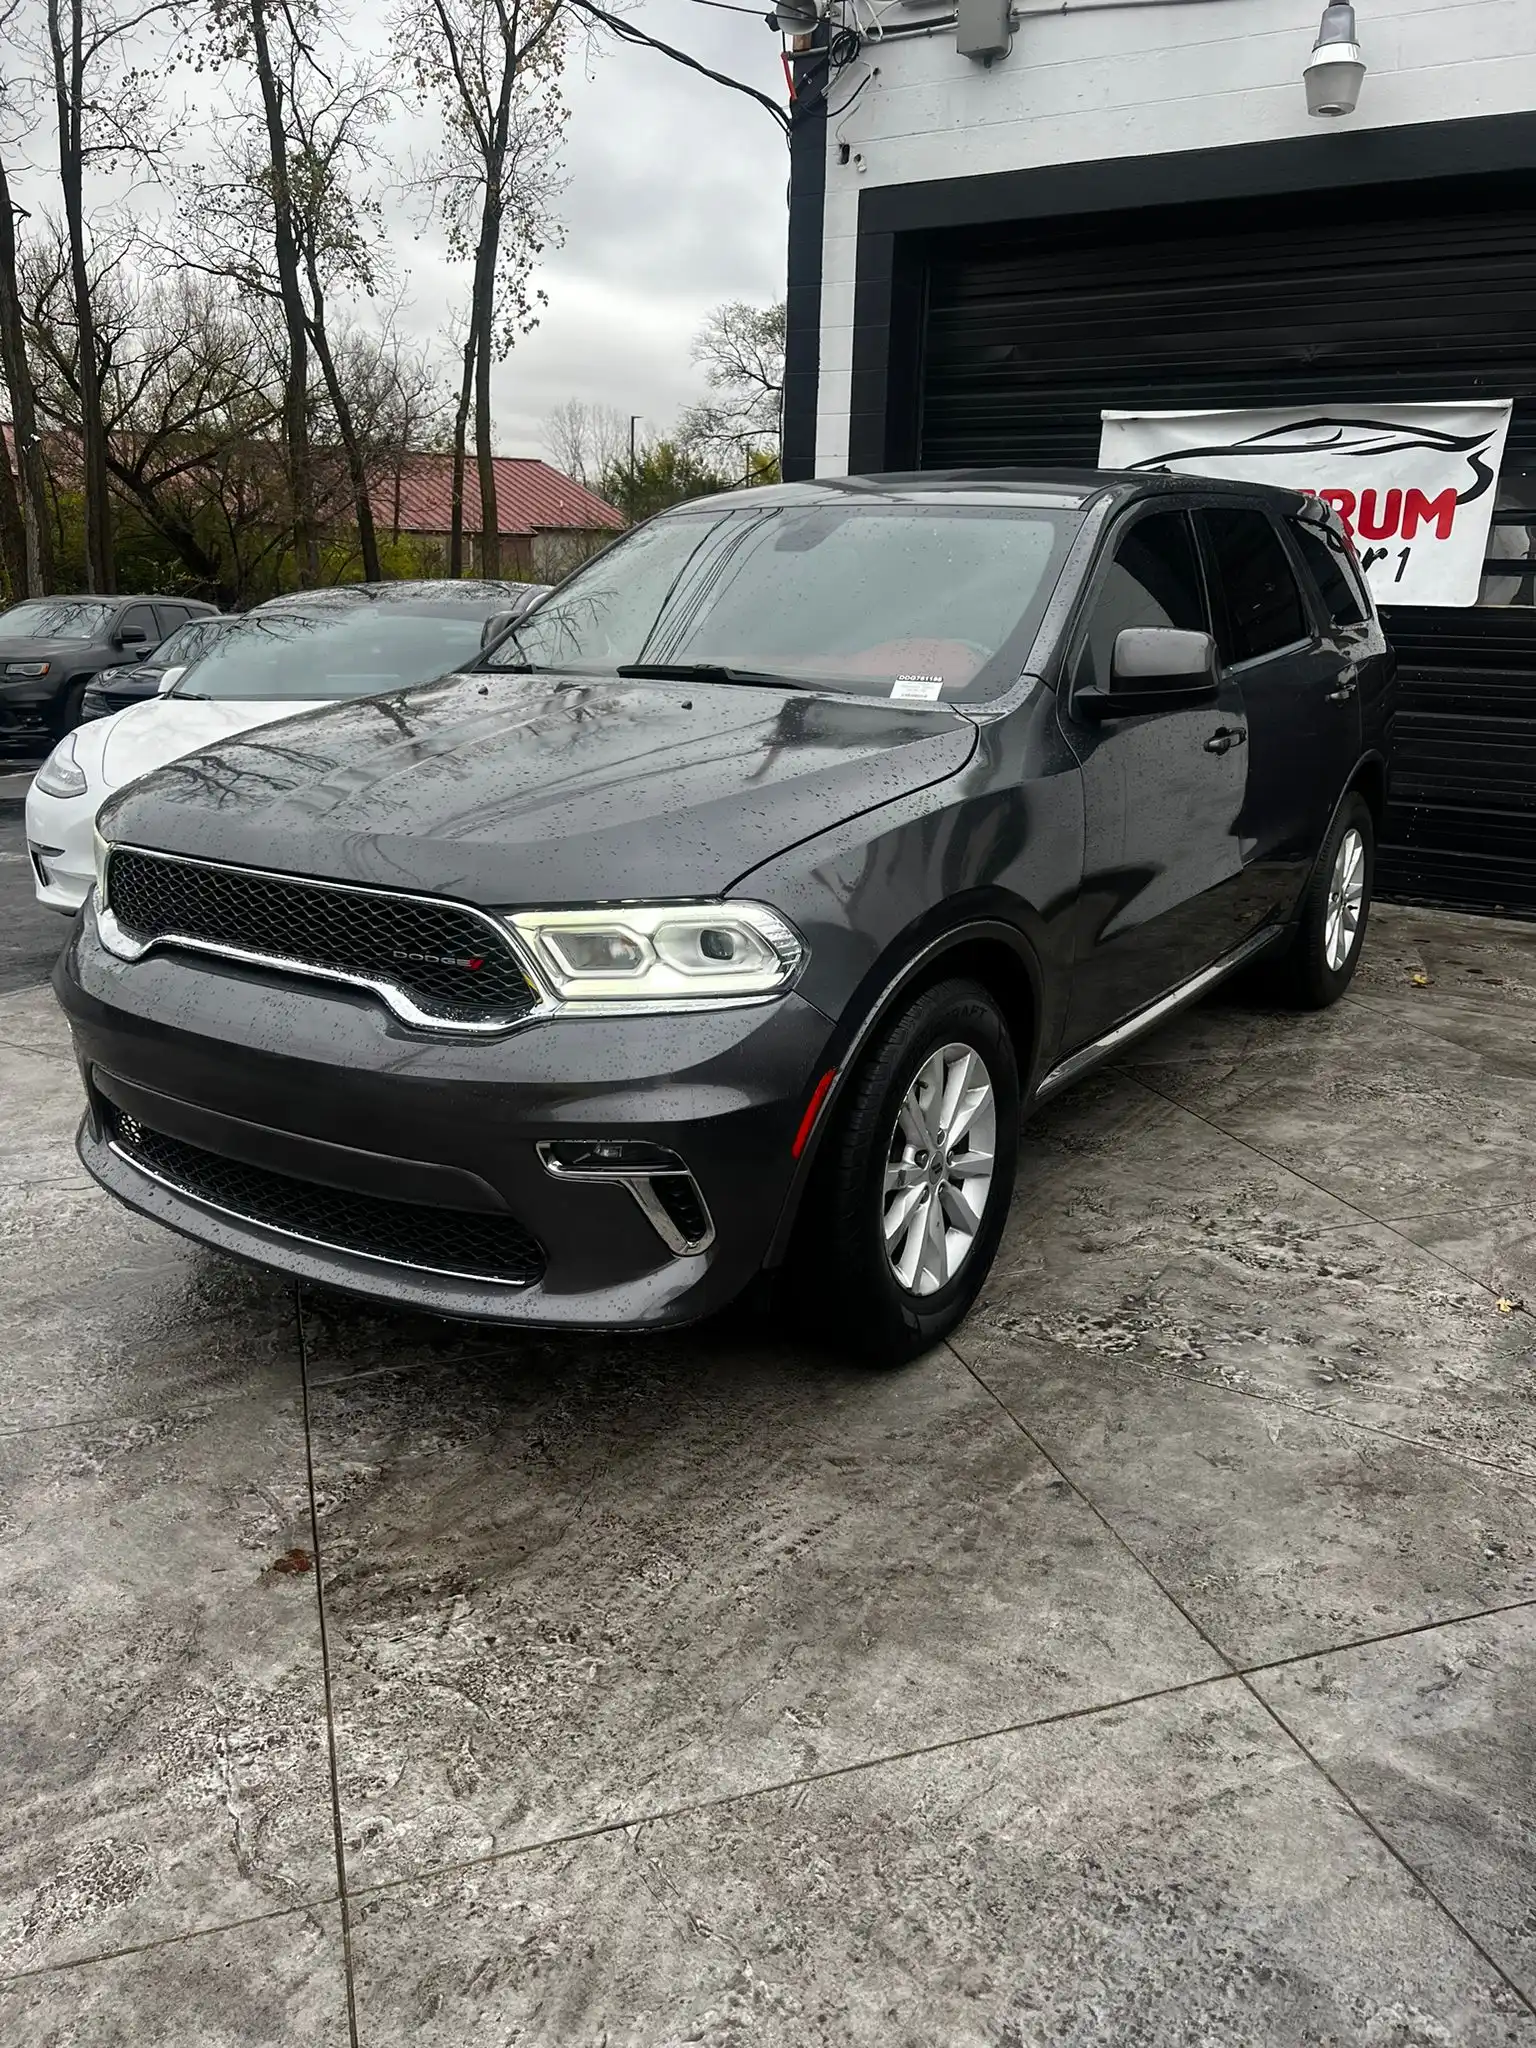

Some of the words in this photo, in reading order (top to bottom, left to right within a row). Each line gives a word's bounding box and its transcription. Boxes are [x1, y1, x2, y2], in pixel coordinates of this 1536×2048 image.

[1296, 488, 1458, 539] RUM
[1393, 547, 1411, 582] 1
[393, 951, 471, 966] DODGE
